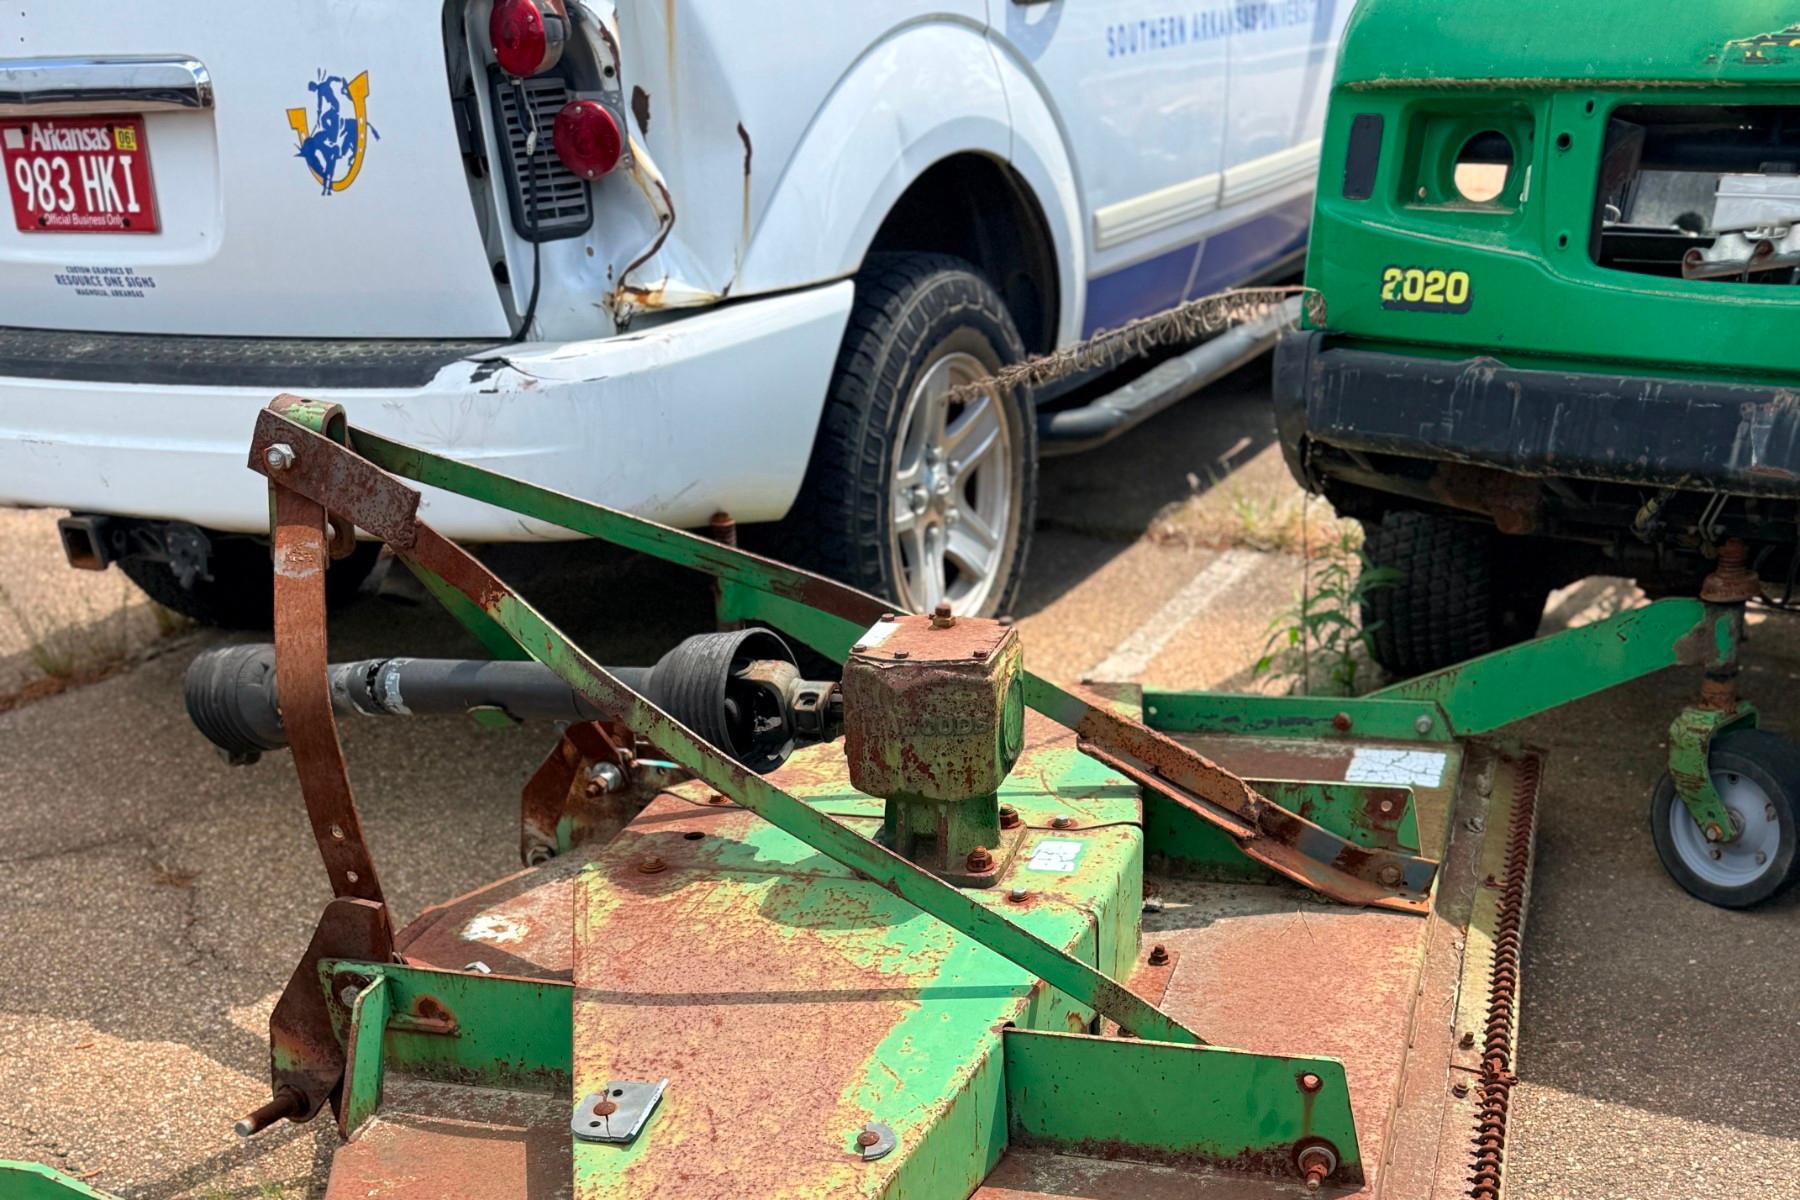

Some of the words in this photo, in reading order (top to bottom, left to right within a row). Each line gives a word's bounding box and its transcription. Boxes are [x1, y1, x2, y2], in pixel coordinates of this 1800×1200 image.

[1107, 16, 1187, 58] SOUTHERN
[30, 122, 111, 151] Arkansas
[15, 156, 75, 212] 983
[79, 155, 140, 213] HKI
[43, 213, 71, 226] Official
[73, 214, 106, 226] Business
[107, 214, 125, 229] Only
[54, 274, 103, 286] RESOURCE
[103, 276, 125, 288] ONE
[125, 276, 156, 288] SIGNS
[1382, 267, 1470, 305] 2020
